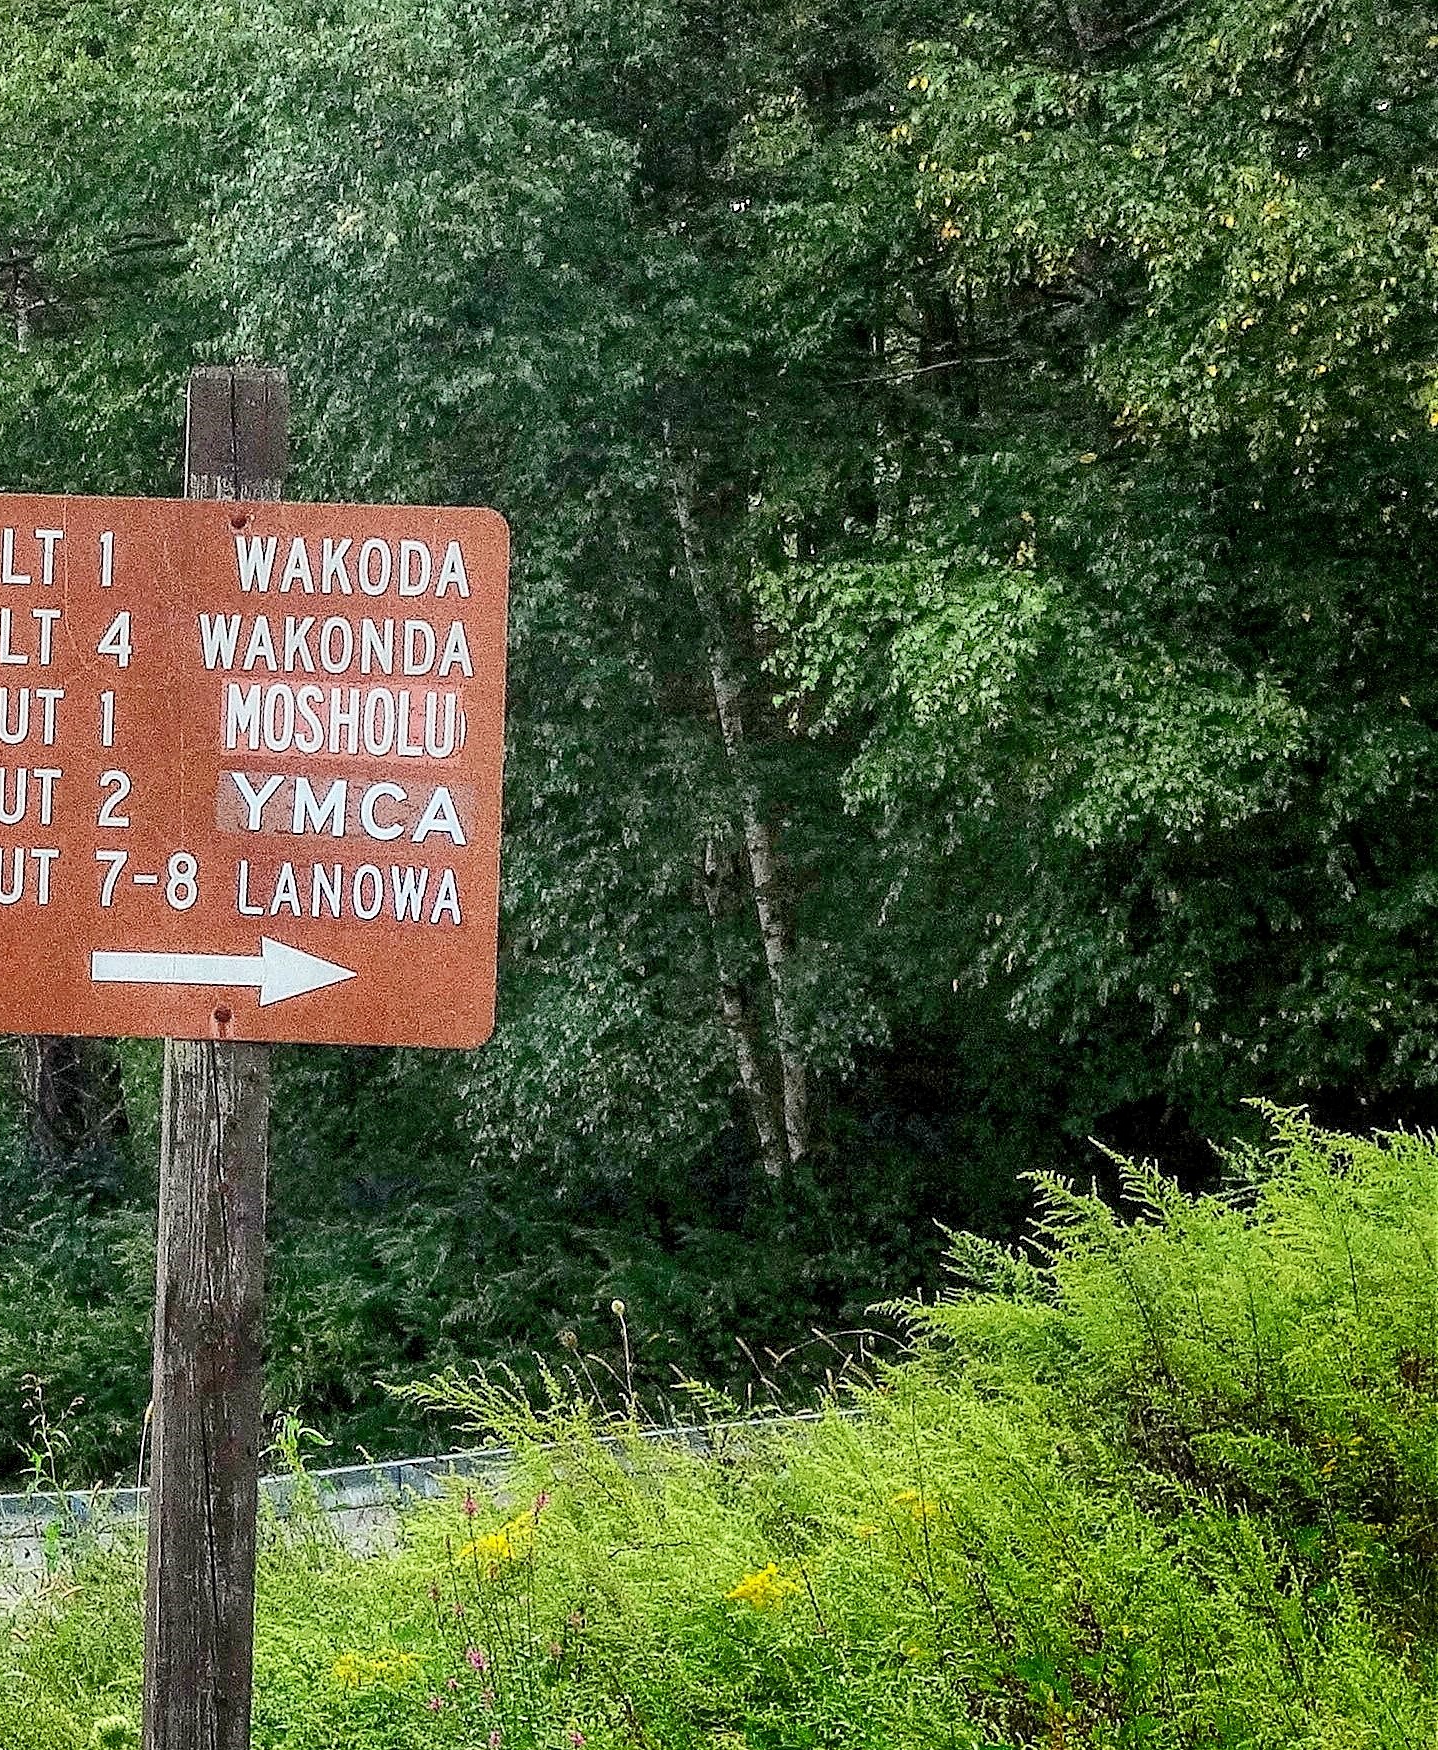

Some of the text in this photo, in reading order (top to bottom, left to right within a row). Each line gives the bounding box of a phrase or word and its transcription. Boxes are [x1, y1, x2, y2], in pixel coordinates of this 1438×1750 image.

[0, 527, 471, 599] LT 1 WAKODA
[97, 610, 132, 668] 4
[199, 613, 473, 678] WAKONDA
[99, 690, 115, 747] 1
[225, 684, 459, 758] MOSHOLU
[98, 770, 132, 828] 2
[230, 771, 467, 846] YMCA
[94, 850, 198, 910] 7-8
[237, 860, 461, 925] LANOWA
